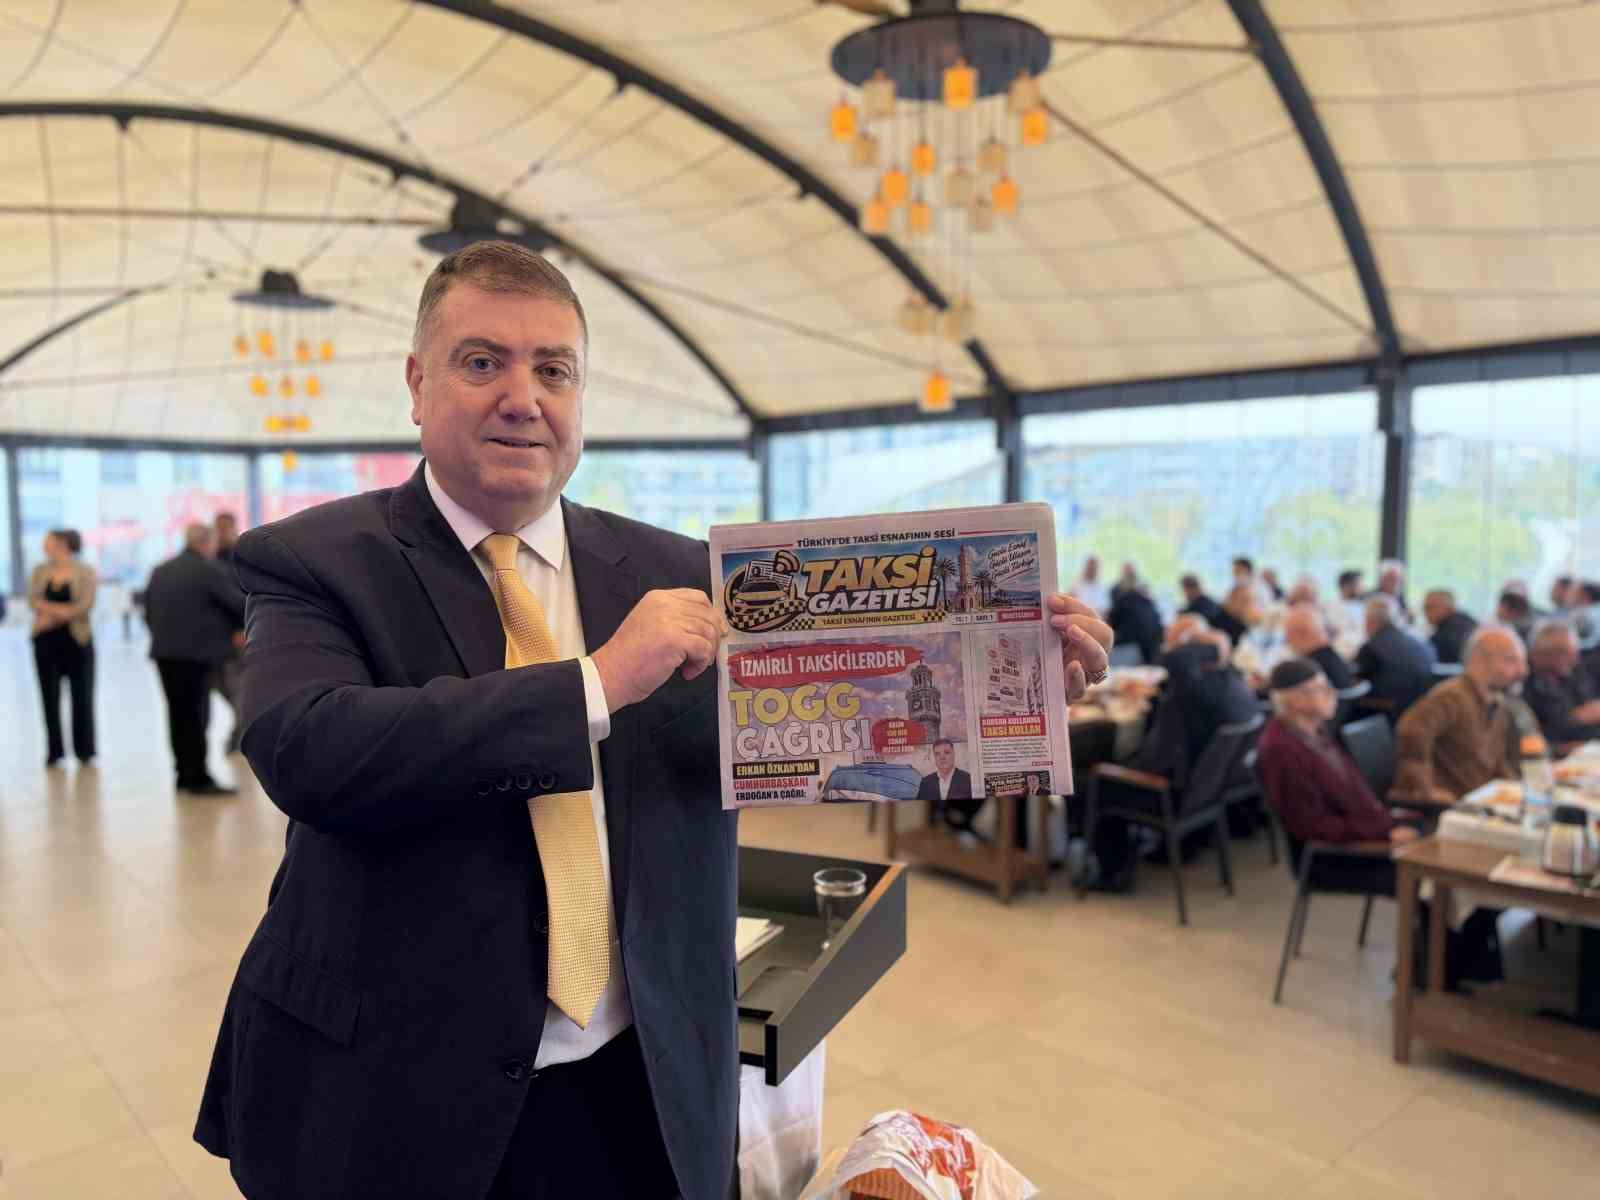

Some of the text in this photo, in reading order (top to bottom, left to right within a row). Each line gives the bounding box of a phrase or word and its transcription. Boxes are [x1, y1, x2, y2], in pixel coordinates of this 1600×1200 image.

[798, 528, 956, 548] TÜRKİYE'DE TAKSİ ESNAFININ SESİ
[804, 545, 936, 592] TAKSİ
[808, 580, 937, 613] GAZETESİ
[822, 614, 915, 626] TAKSİ ESNAFININ GAZETESİ
[740, 650, 906, 677] İZMİRLİ TAKSİCİLERDEN
[728, 682, 861, 726] TOGG
[736, 719, 872, 761] ÇAĞRISI
[983, 724, 1040, 737] TAKSİ KULLAN
[737, 762, 816, 776] ERKAN ÖZKAN'DAN
